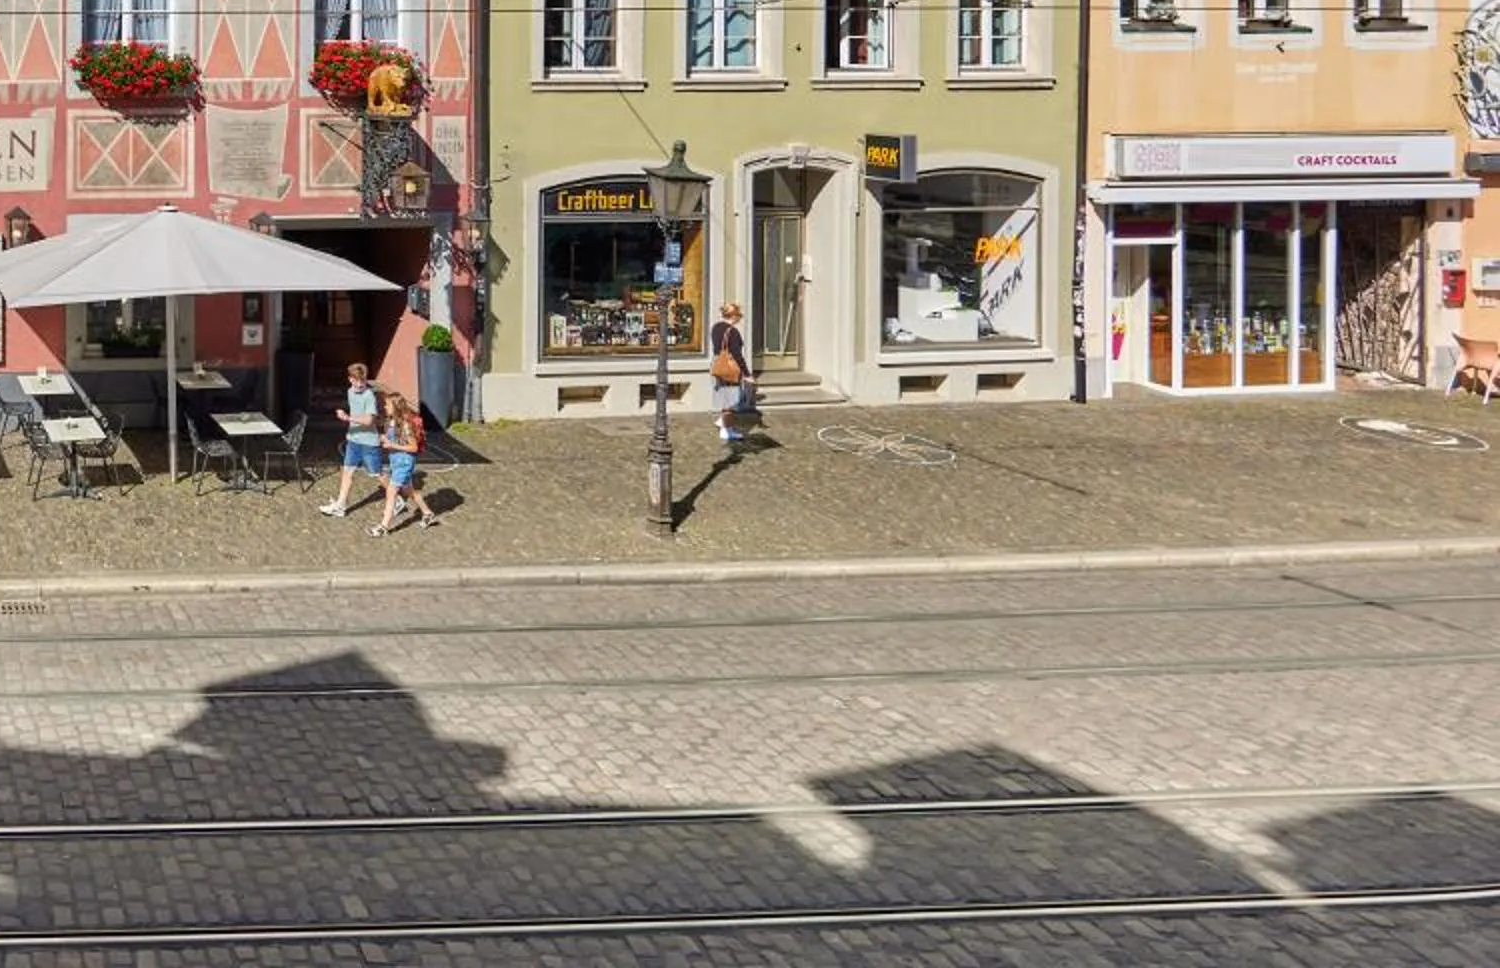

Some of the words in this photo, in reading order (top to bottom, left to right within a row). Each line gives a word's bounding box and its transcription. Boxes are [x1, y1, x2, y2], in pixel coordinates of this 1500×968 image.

[867, 146, 899, 163] PARK
[1298, 155, 1334, 167] CRAFT
[1336, 153, 1397, 166] COCKTAILS
[558, 189, 634, 212] Craftbeer
